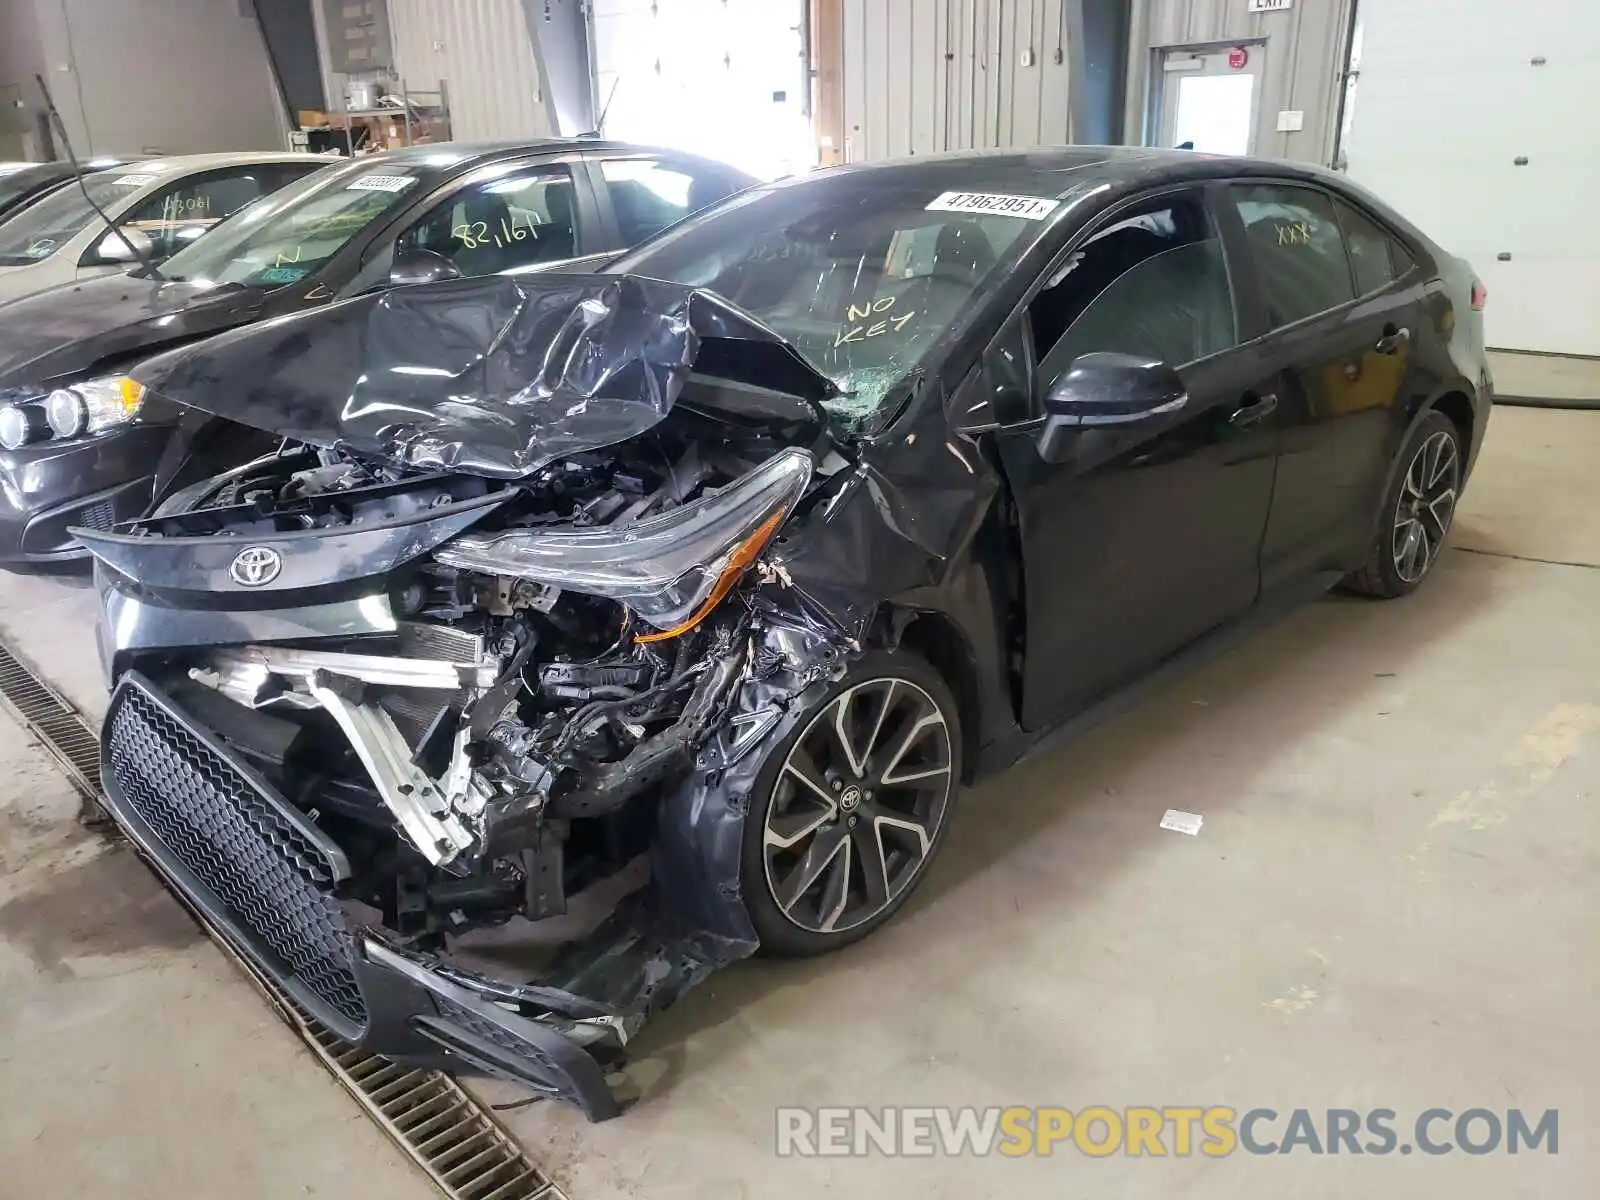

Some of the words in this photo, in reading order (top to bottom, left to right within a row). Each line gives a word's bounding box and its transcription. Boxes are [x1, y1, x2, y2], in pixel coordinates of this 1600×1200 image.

[946, 194, 1040, 214] 47962951
[846, 296, 896, 322] NO
[833, 311, 916, 348] KEY
